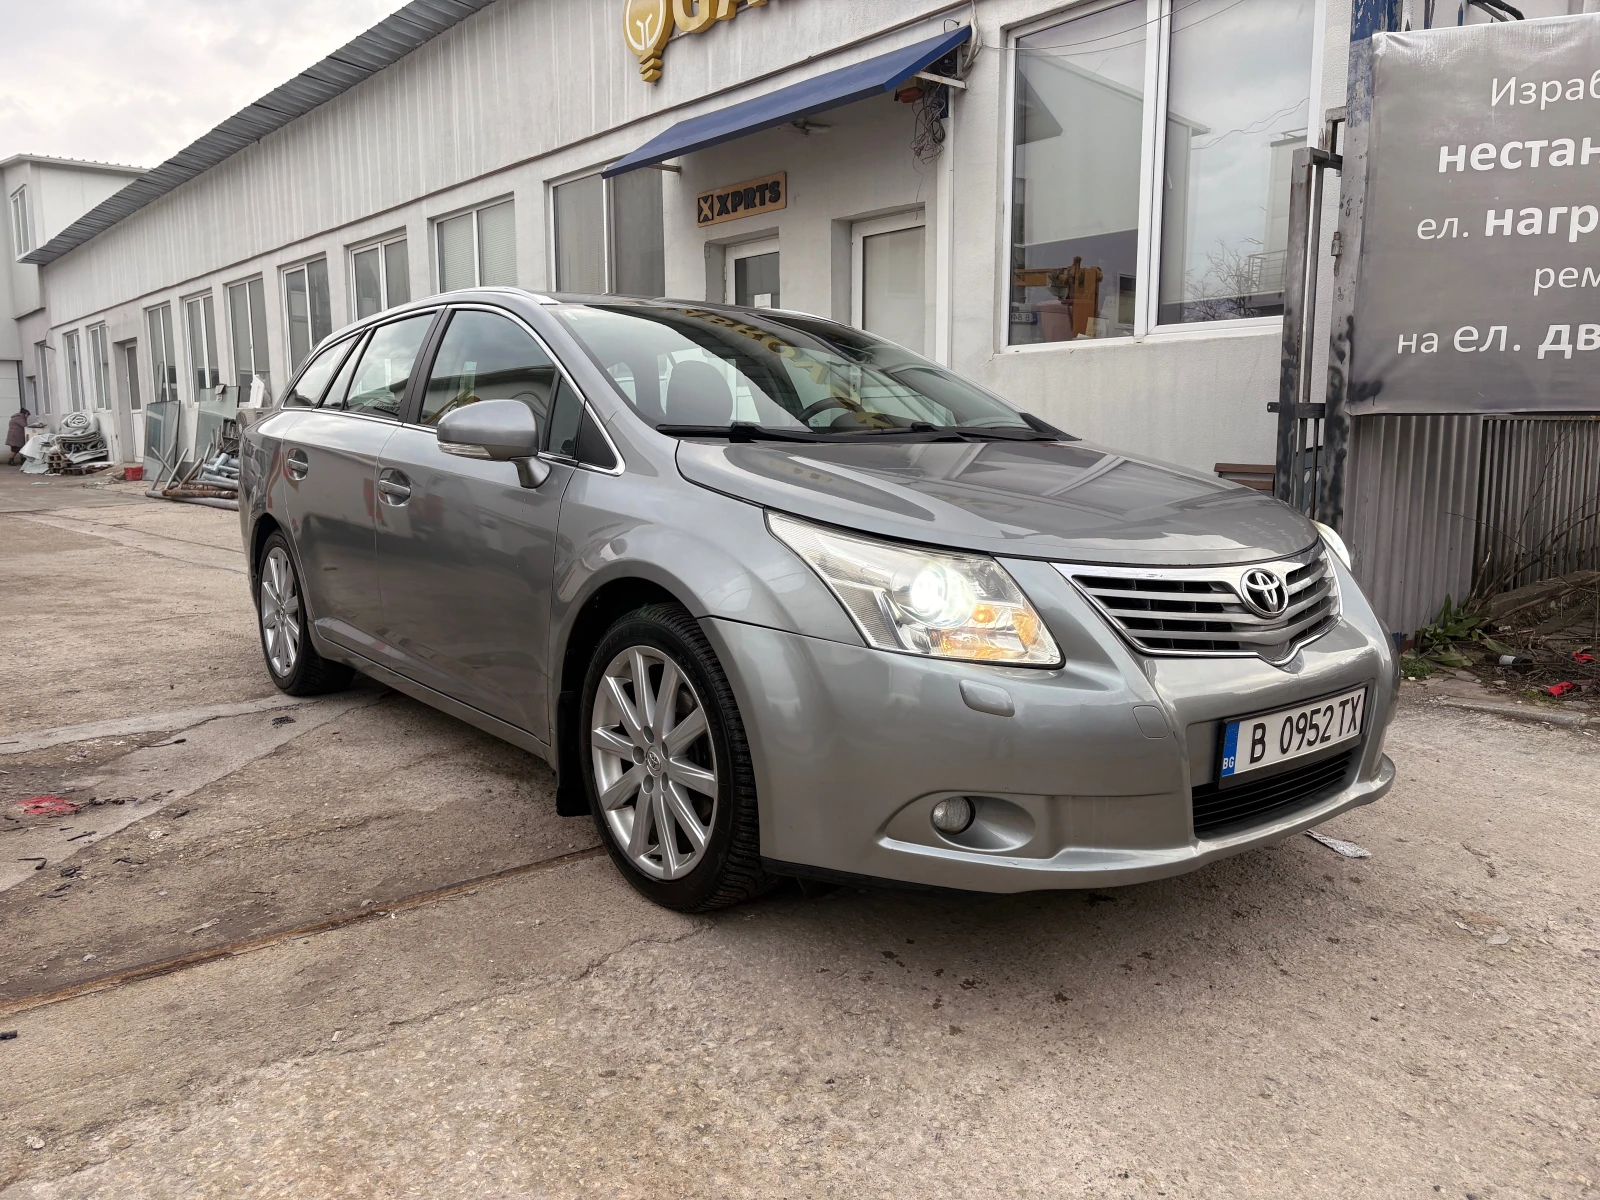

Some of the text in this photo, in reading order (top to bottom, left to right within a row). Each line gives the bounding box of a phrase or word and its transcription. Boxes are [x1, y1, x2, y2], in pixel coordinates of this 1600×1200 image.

[1491, 69, 1600, 111] Израб
[1439, 137, 1600, 173] нестан
[716, 181, 781, 216] XPRTS
[1417, 204, 1599, 242] ел. нагр
[1533, 266, 1600, 296] рем
[1397, 323, 1600, 360] на ел. дв
[1222, 756, 1235, 770] BG
